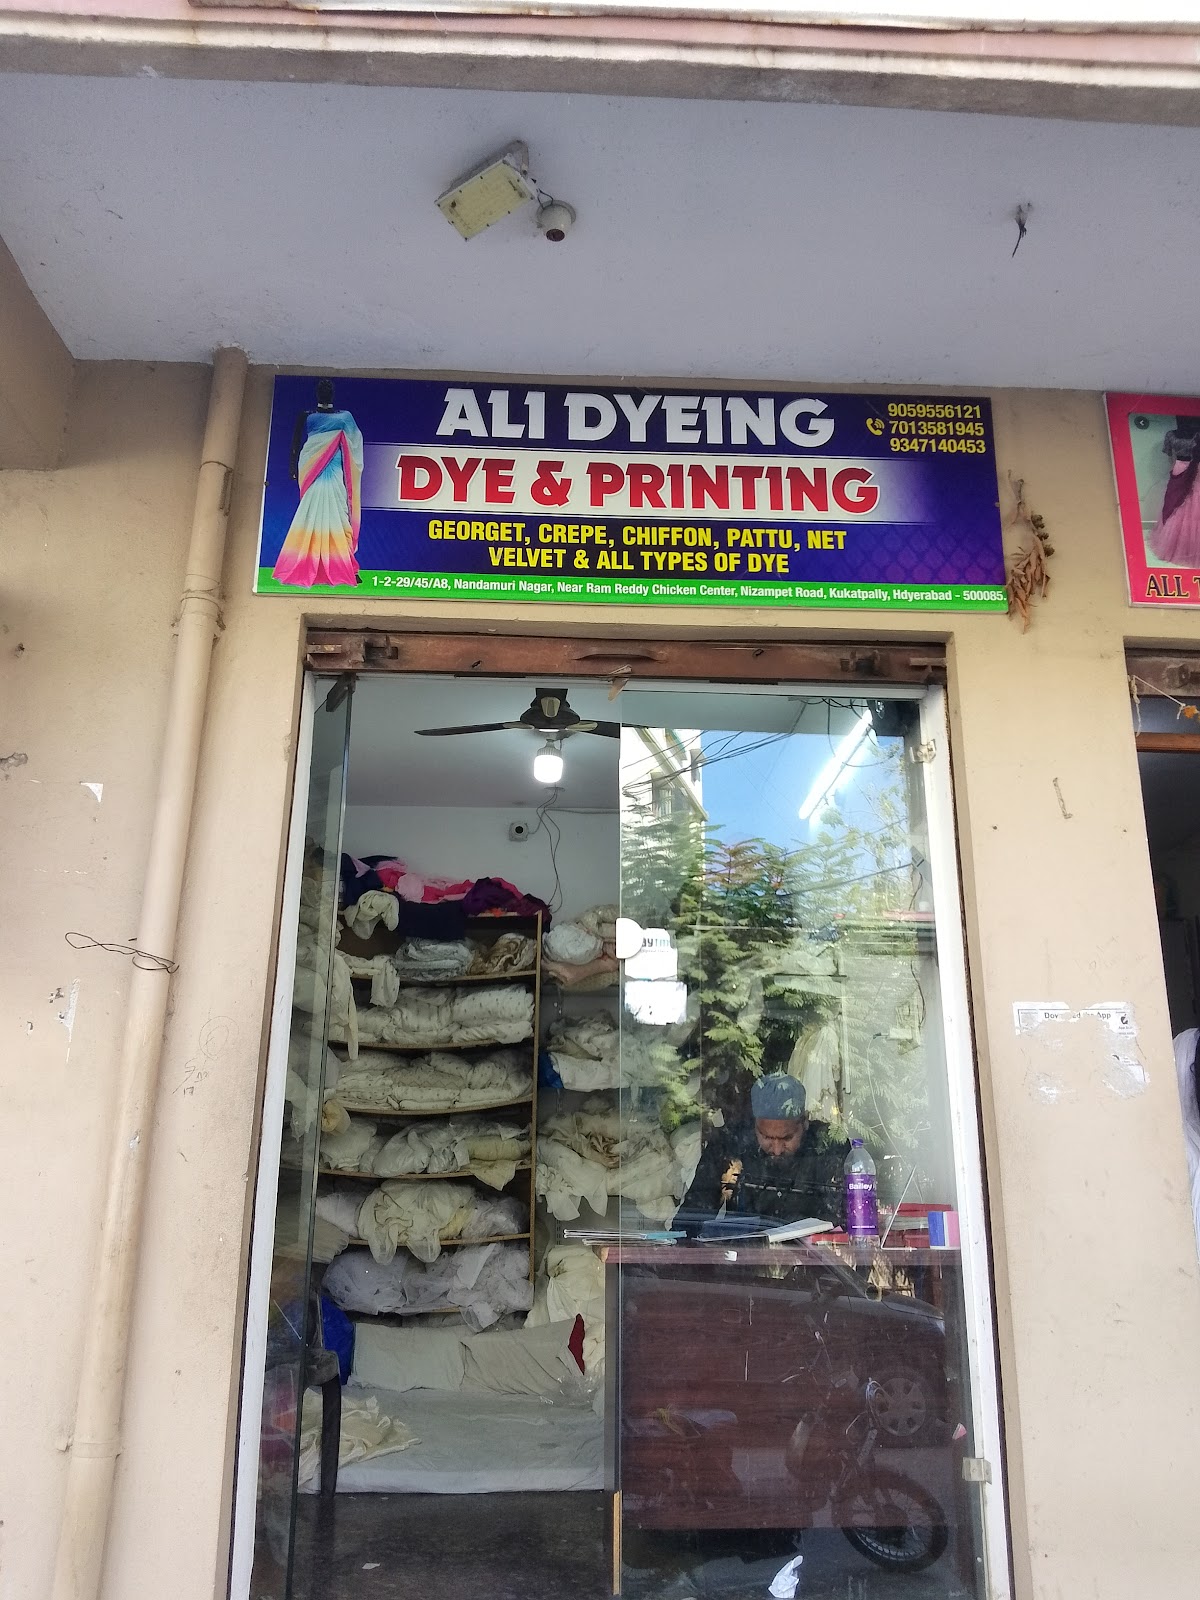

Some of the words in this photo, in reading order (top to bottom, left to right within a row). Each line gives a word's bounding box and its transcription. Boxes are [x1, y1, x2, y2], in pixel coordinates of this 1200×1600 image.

[436, 388, 545, 439] ALI
[564, 392, 835, 448] DYEING
[888, 403, 981, 419] 9059556121
[889, 420, 985, 436] 7013581945
[890, 438, 986, 453] 9347140453
[397, 455, 516, 504] DYE
[530, 460, 572, 507] &
[586, 461, 879, 514] PRINTING
[428, 519, 531, 546] GEORGET,
[538, 523, 615, 548] CREPE,
[622, 525, 720, 551] CHIFFON,
[727, 528, 800, 552] PATTU,
[807, 530, 847, 550] NET
[488, 546, 566, 568] VELVET
[573, 549, 590, 570] &
[596, 550, 635, 570] ALL
[640, 551, 708, 572] TYPES
[714, 553, 741, 572] OF
[748, 553, 790, 573] DYE
[371, 575, 451, 591] 1-2-29/45/A8,
[453, 578, 516, 591] Nandamuri
[518, 580, 555, 593] Nagar,
[557, 582, 583, 593] Near
[586, 582, 611, 594] Ram
[614, 583, 649, 597] Reddy
[652, 583, 697, 595] Chicken
[699, 585, 738, 598] Center,
[740, 586, 793, 598] Nizampet
[795, 587, 827, 599] Road,
[829, 588, 891, 601] Kukatpally,
[893, 588, 952, 602] Hdyerabad
[962, 590, 1007, 601] 500085.
[1145, 574, 1190, 598] ALL
